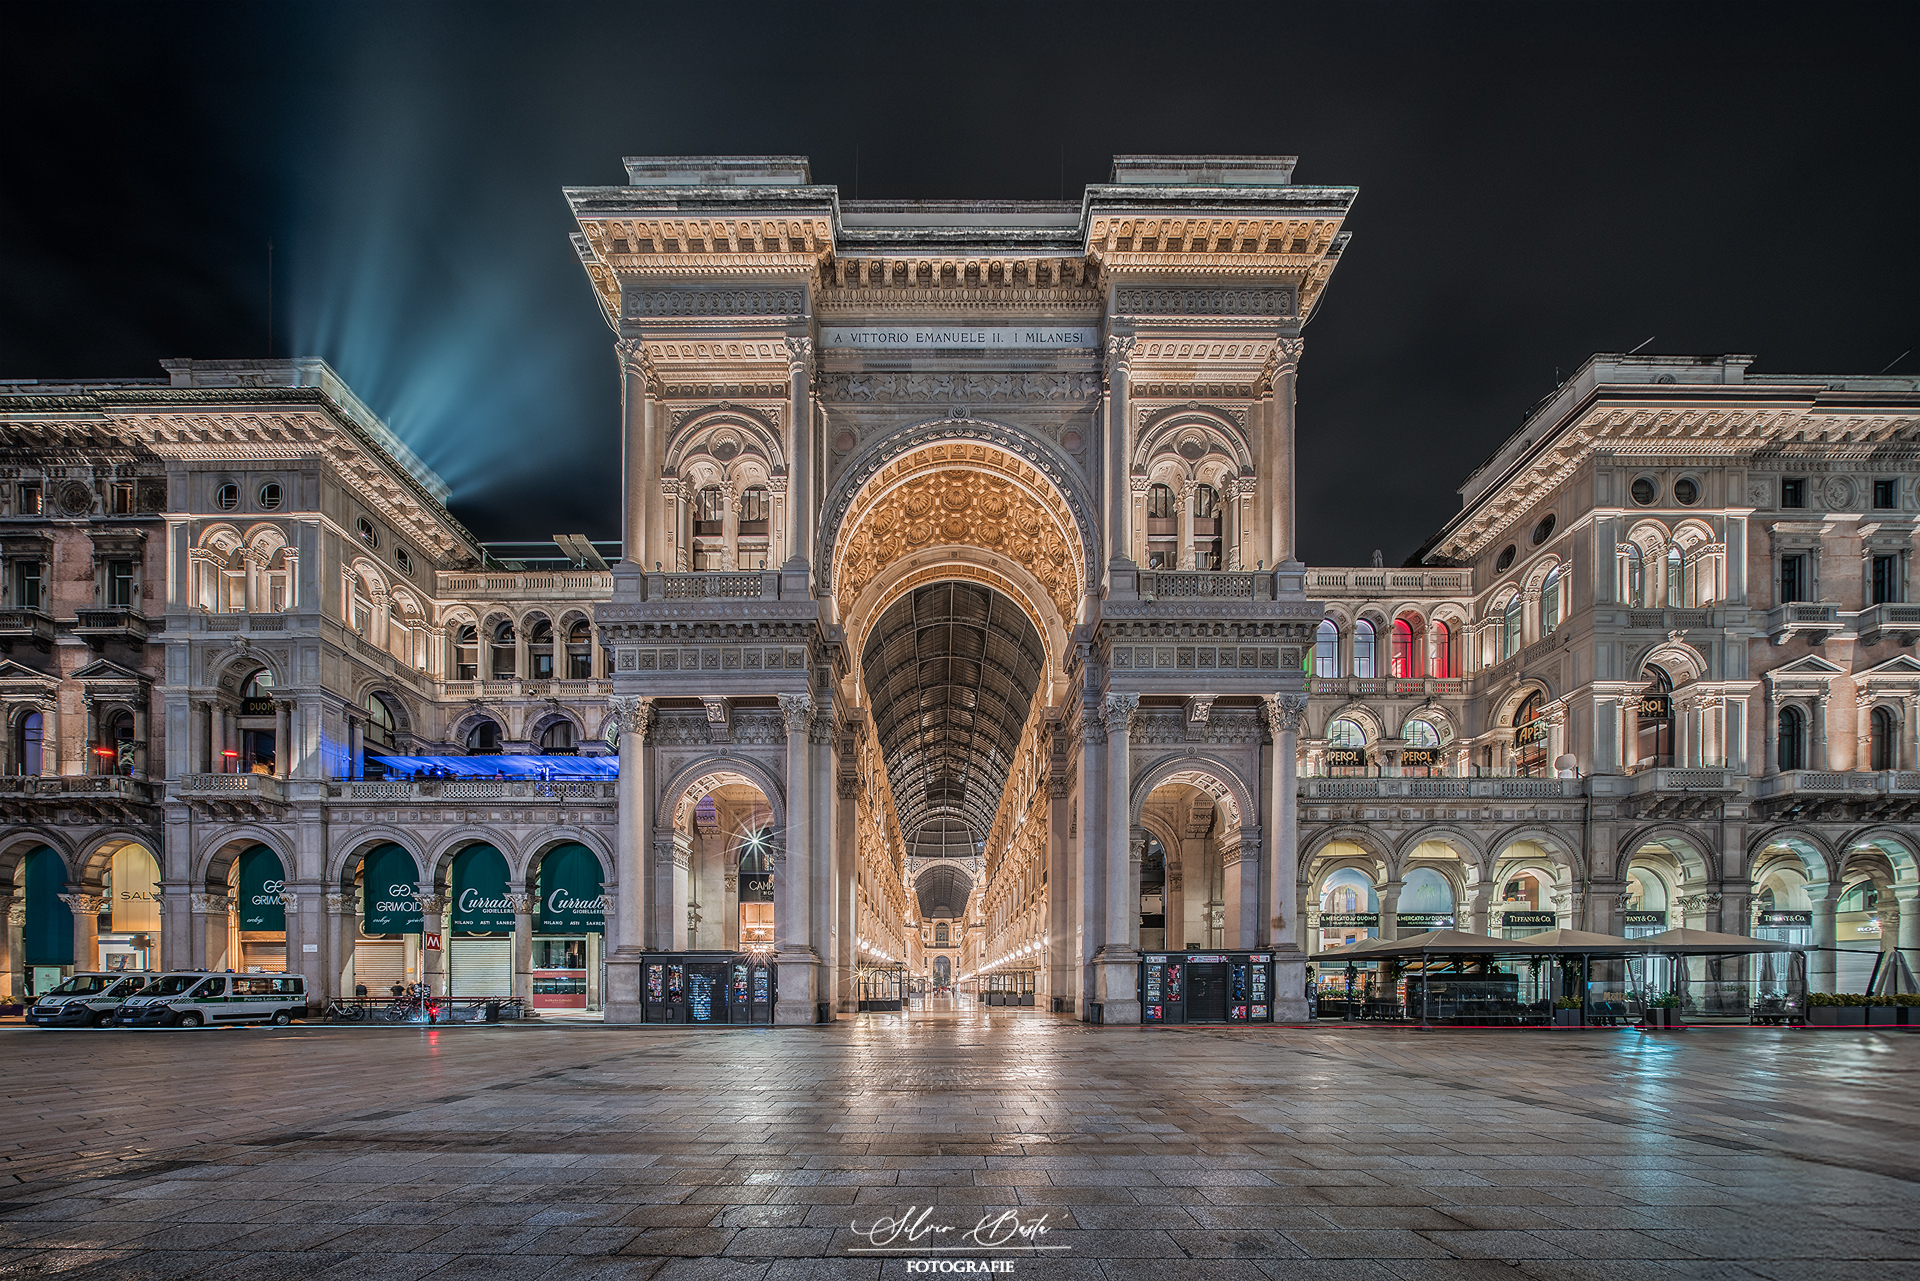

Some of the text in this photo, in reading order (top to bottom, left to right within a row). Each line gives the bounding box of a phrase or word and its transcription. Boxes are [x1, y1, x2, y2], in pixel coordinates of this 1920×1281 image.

[834, 333, 842, 342] A
[850, 332, 909, 342] VITTORIO
[916, 332, 986, 342] EMANUELE
[1014, 332, 1018, 342] I
[1025, 332, 1083, 342] MILANESI
